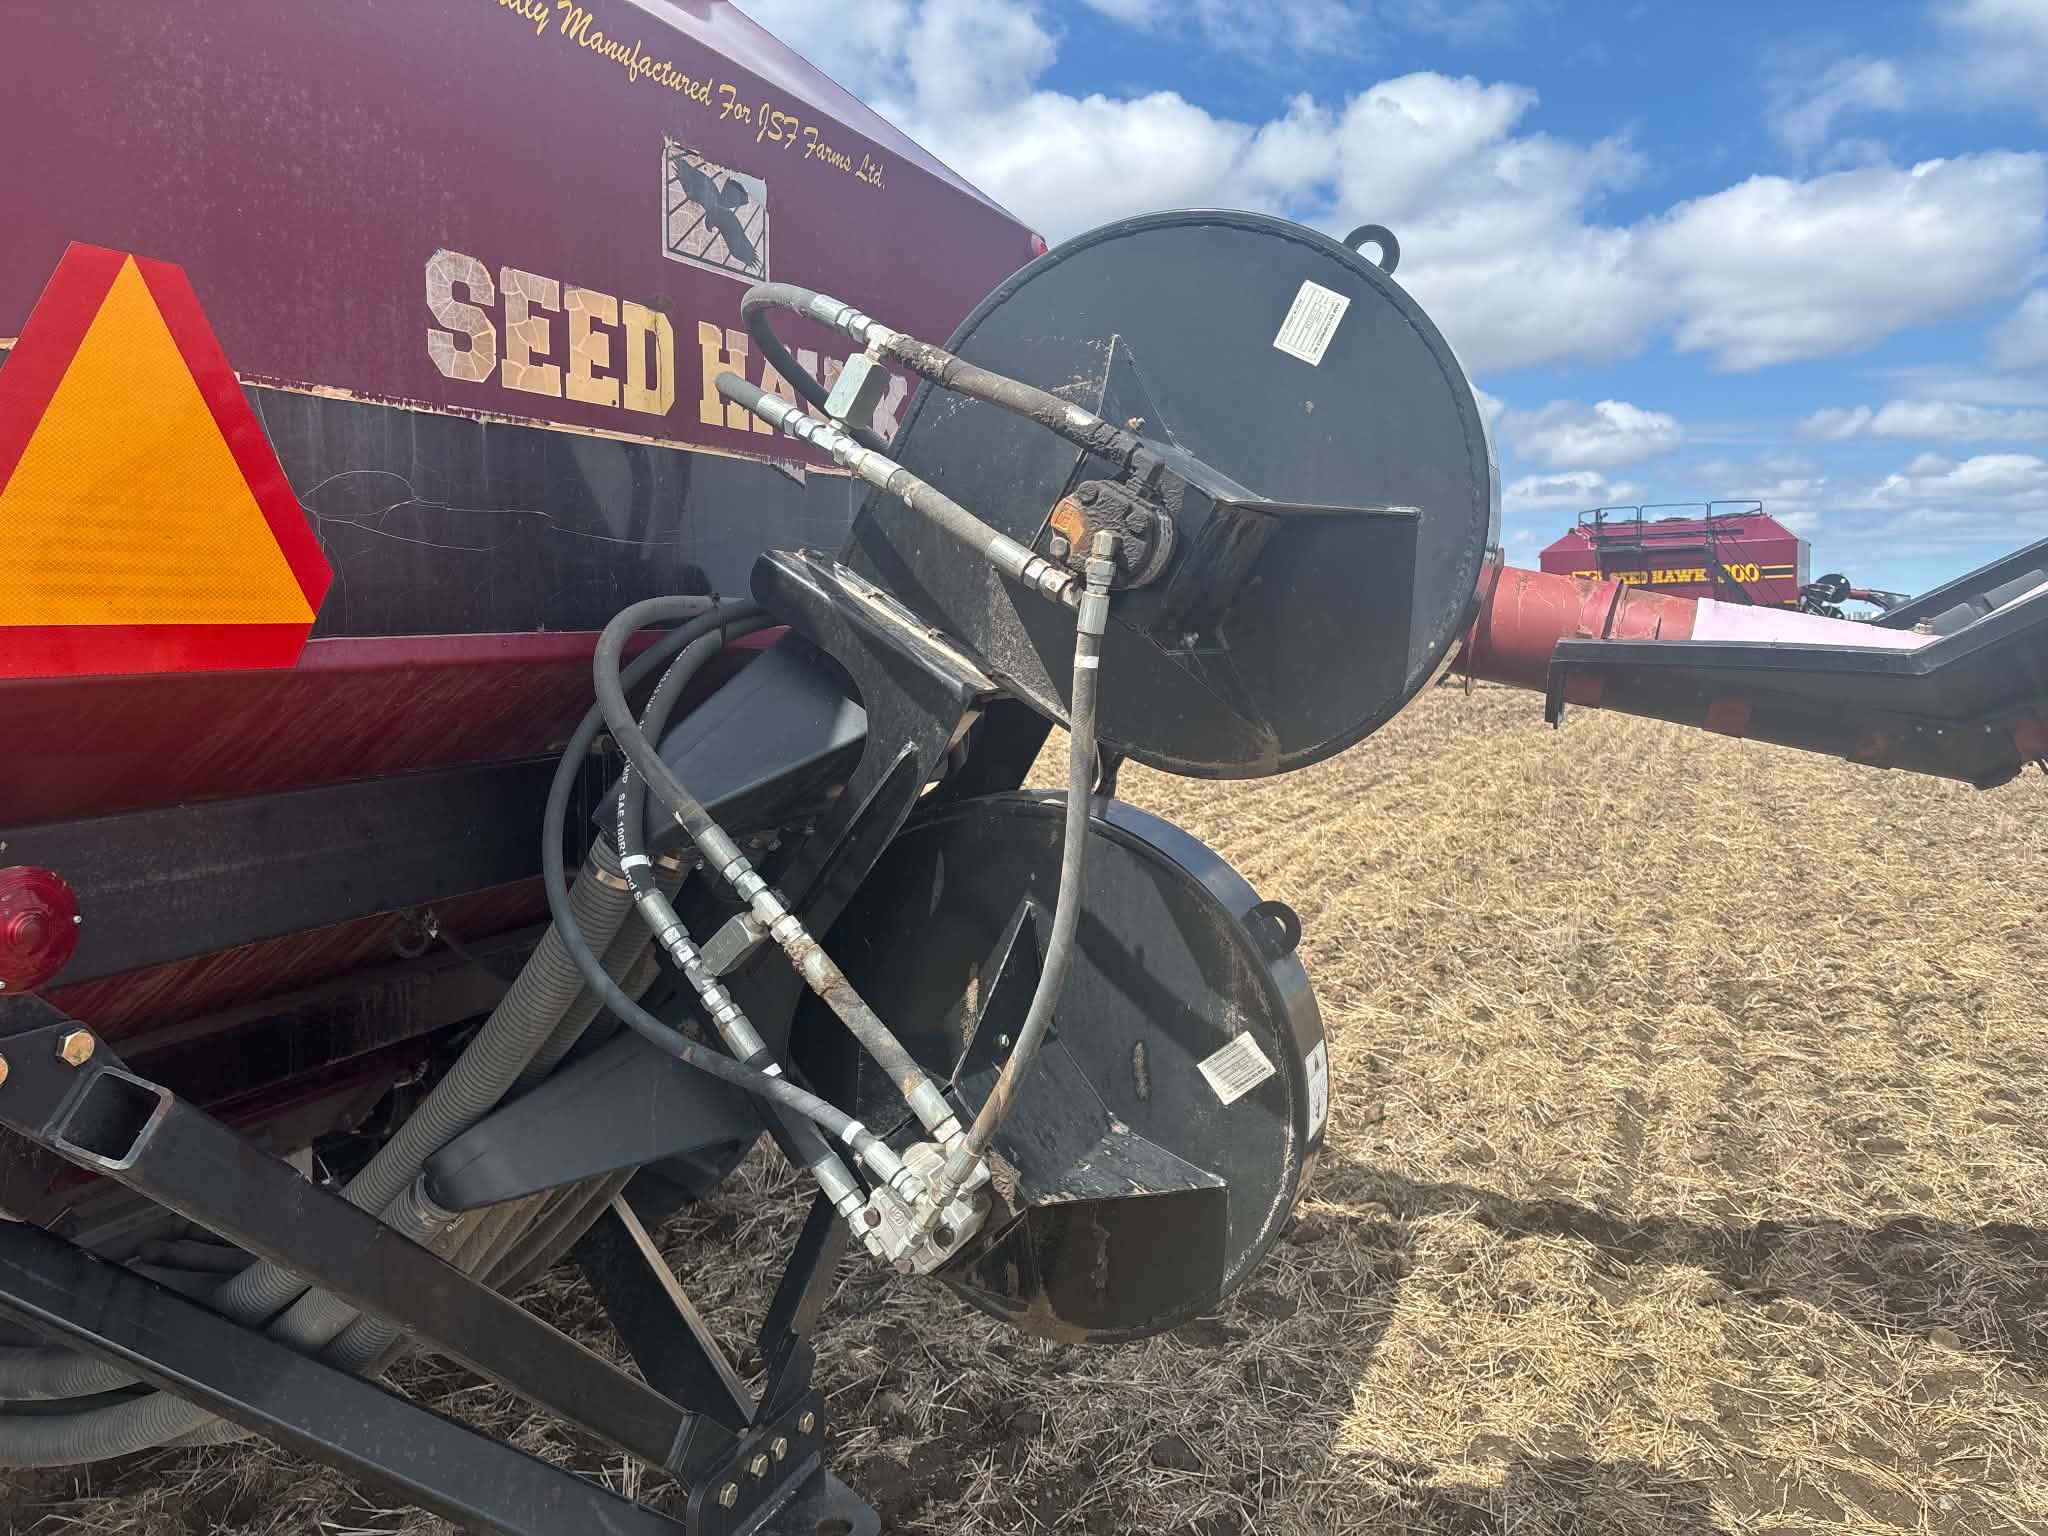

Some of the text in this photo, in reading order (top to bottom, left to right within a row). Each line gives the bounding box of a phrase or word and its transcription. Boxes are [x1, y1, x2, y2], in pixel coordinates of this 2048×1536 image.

[557, 0, 713, 106] Manufactured
[719, 84, 751, 124] For
[803, 126, 852, 171] Farms
[854, 153, 885, 190] Ltd.
[425, 247, 675, 417] SEED
[1651, 567, 1708, 584] HAWK
